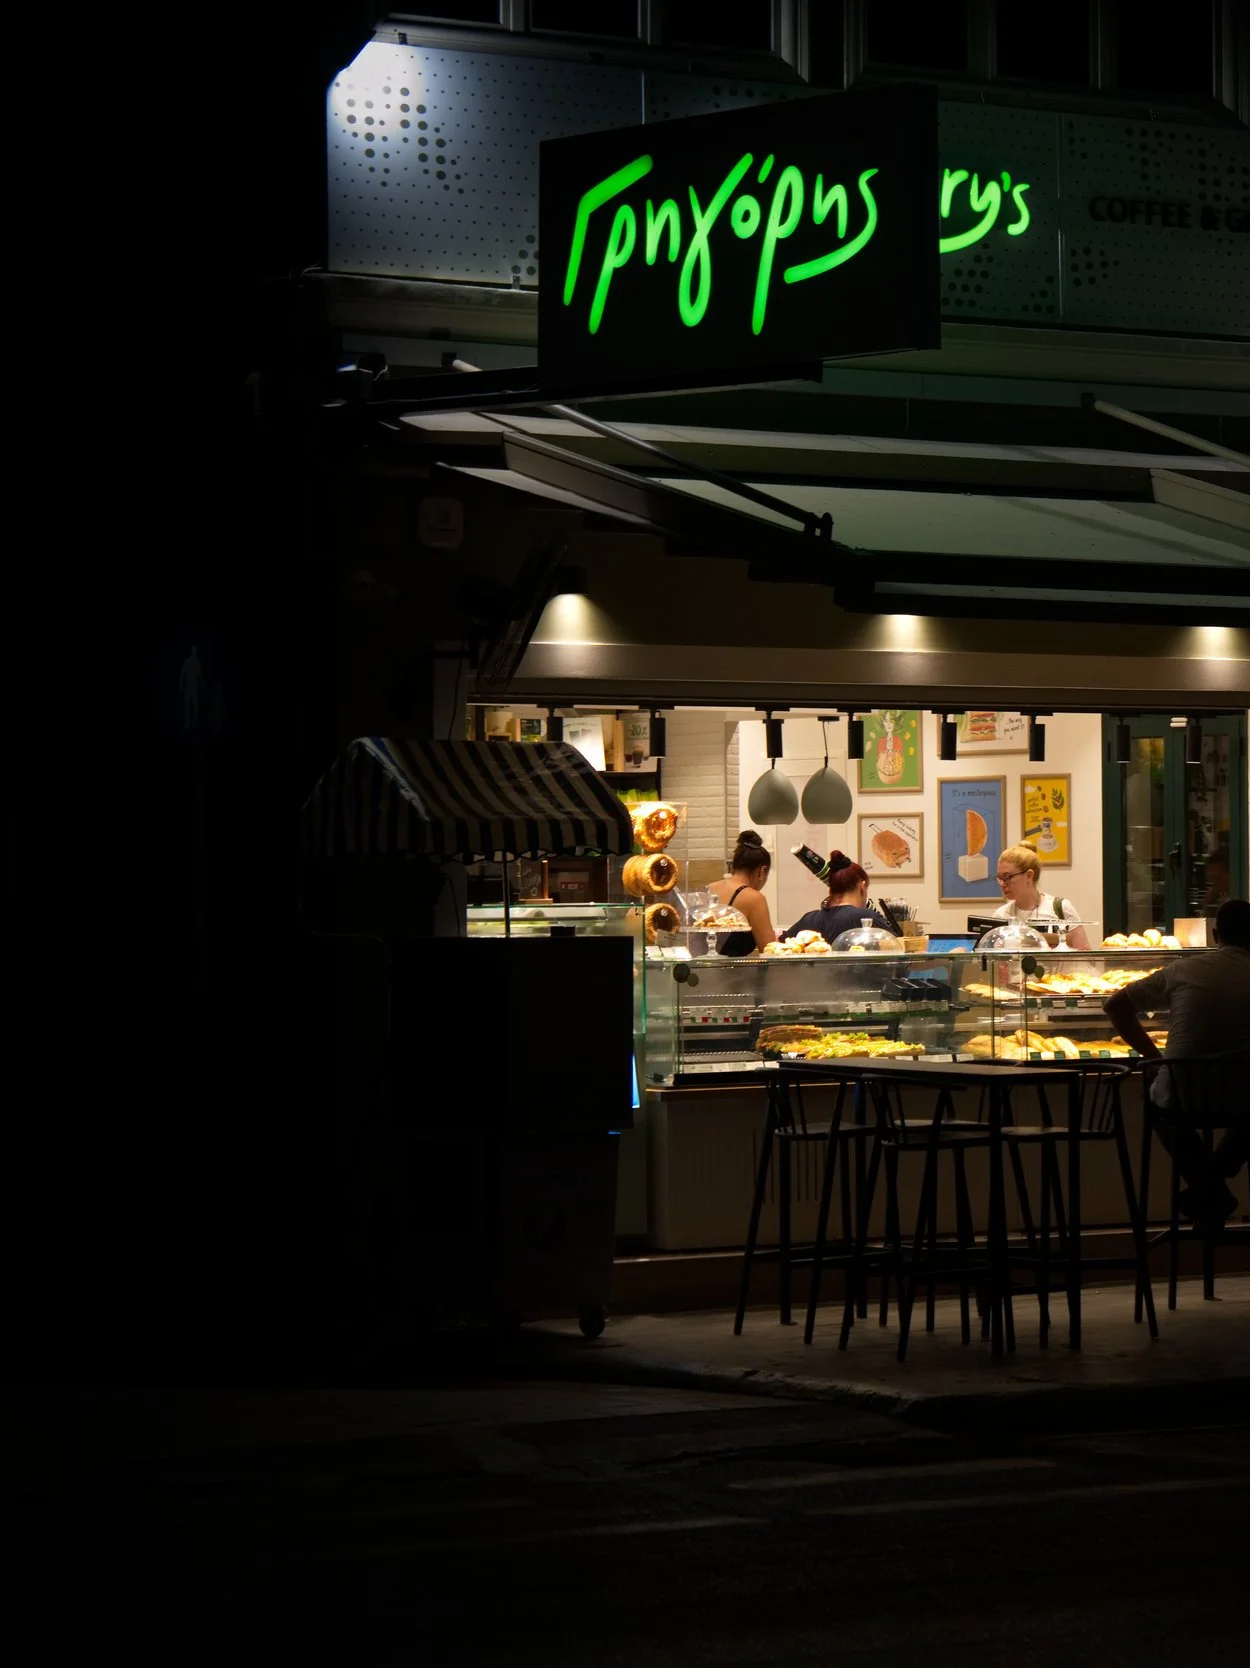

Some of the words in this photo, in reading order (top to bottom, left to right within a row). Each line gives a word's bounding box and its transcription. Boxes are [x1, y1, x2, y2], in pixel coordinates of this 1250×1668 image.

[562, 152, 880, 336] Γρηγόρης
[938, 166, 1032, 254] ry's
[1088, 196, 1193, 229] COFFEE
